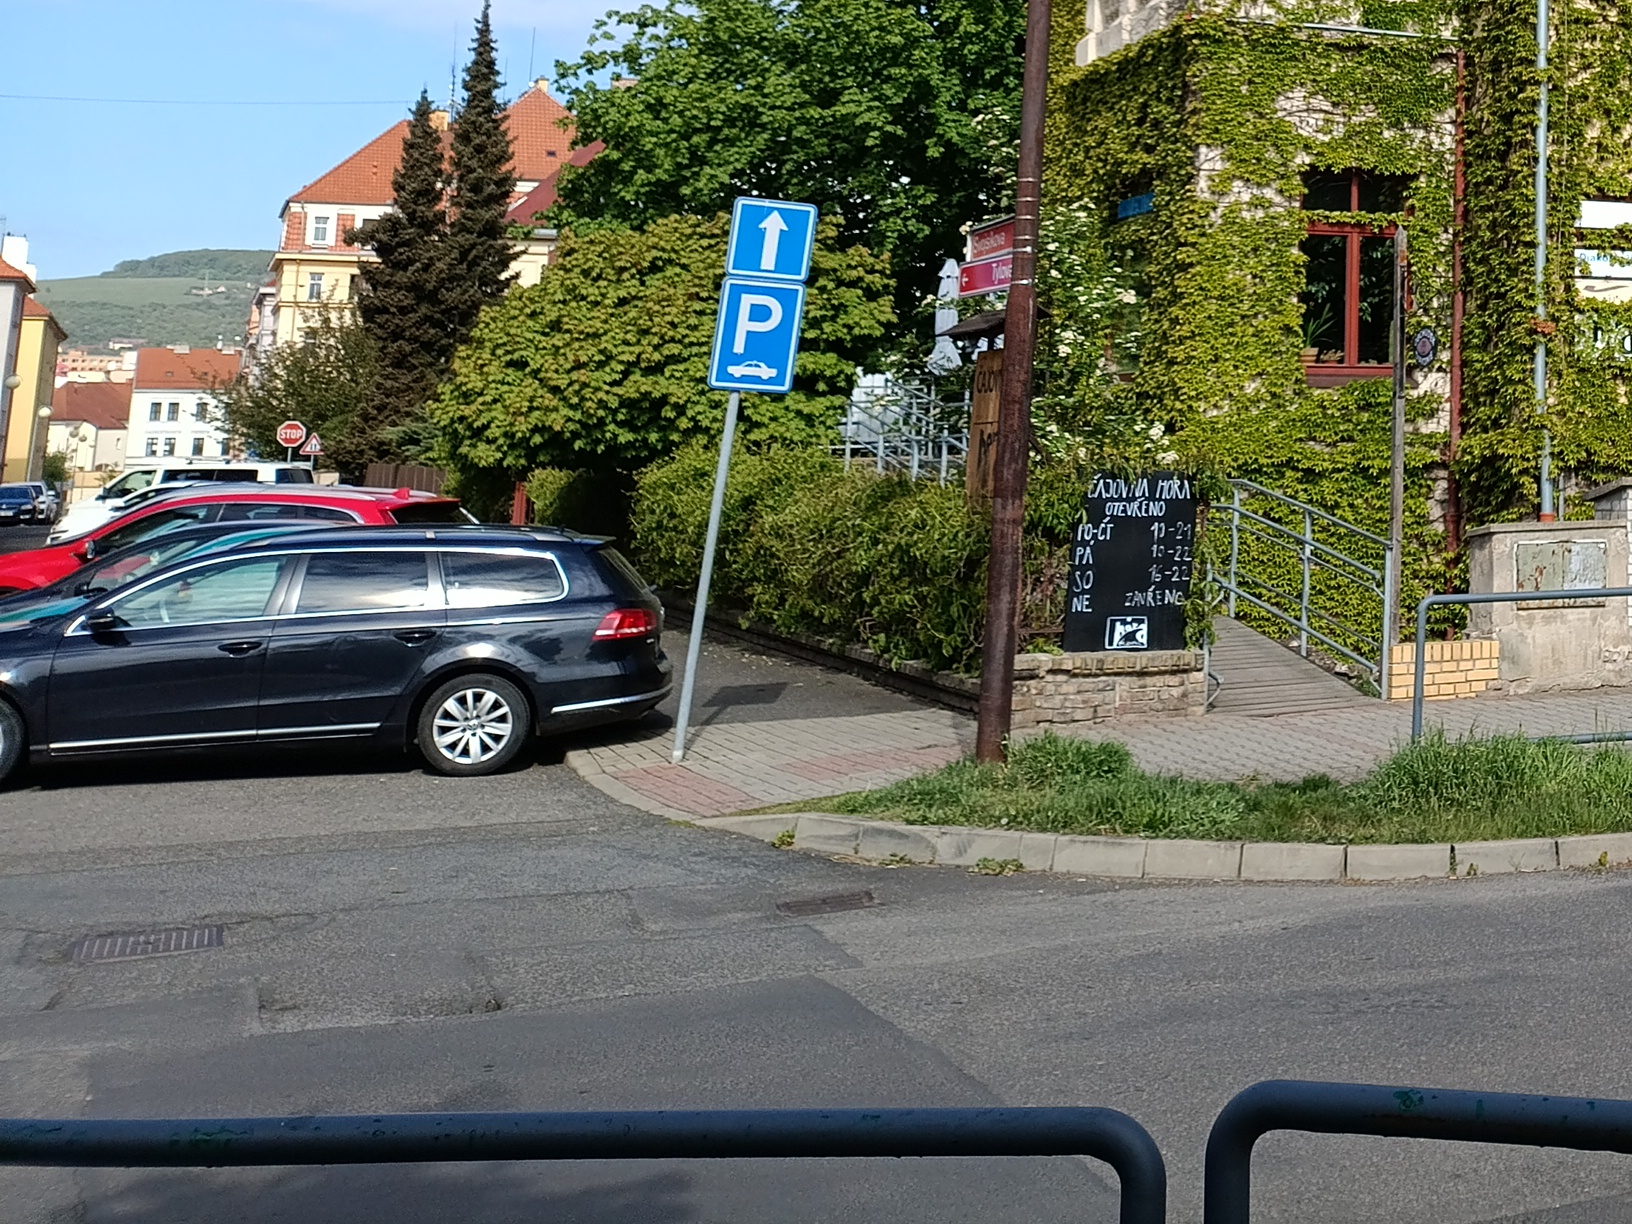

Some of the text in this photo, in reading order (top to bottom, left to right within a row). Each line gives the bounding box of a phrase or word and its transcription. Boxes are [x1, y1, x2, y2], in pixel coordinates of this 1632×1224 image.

[733, 293, 783, 354] P
[280, 429, 303, 439] STOP
[1155, 479, 1191, 499] HORA
[1105, 497, 1166, 517] OTEVŘENO
[1075, 540, 1095, 565] PÁ
[1073, 570, 1094, 592] SO
[1072, 585, 1186, 613] NE ZAVŘENO
